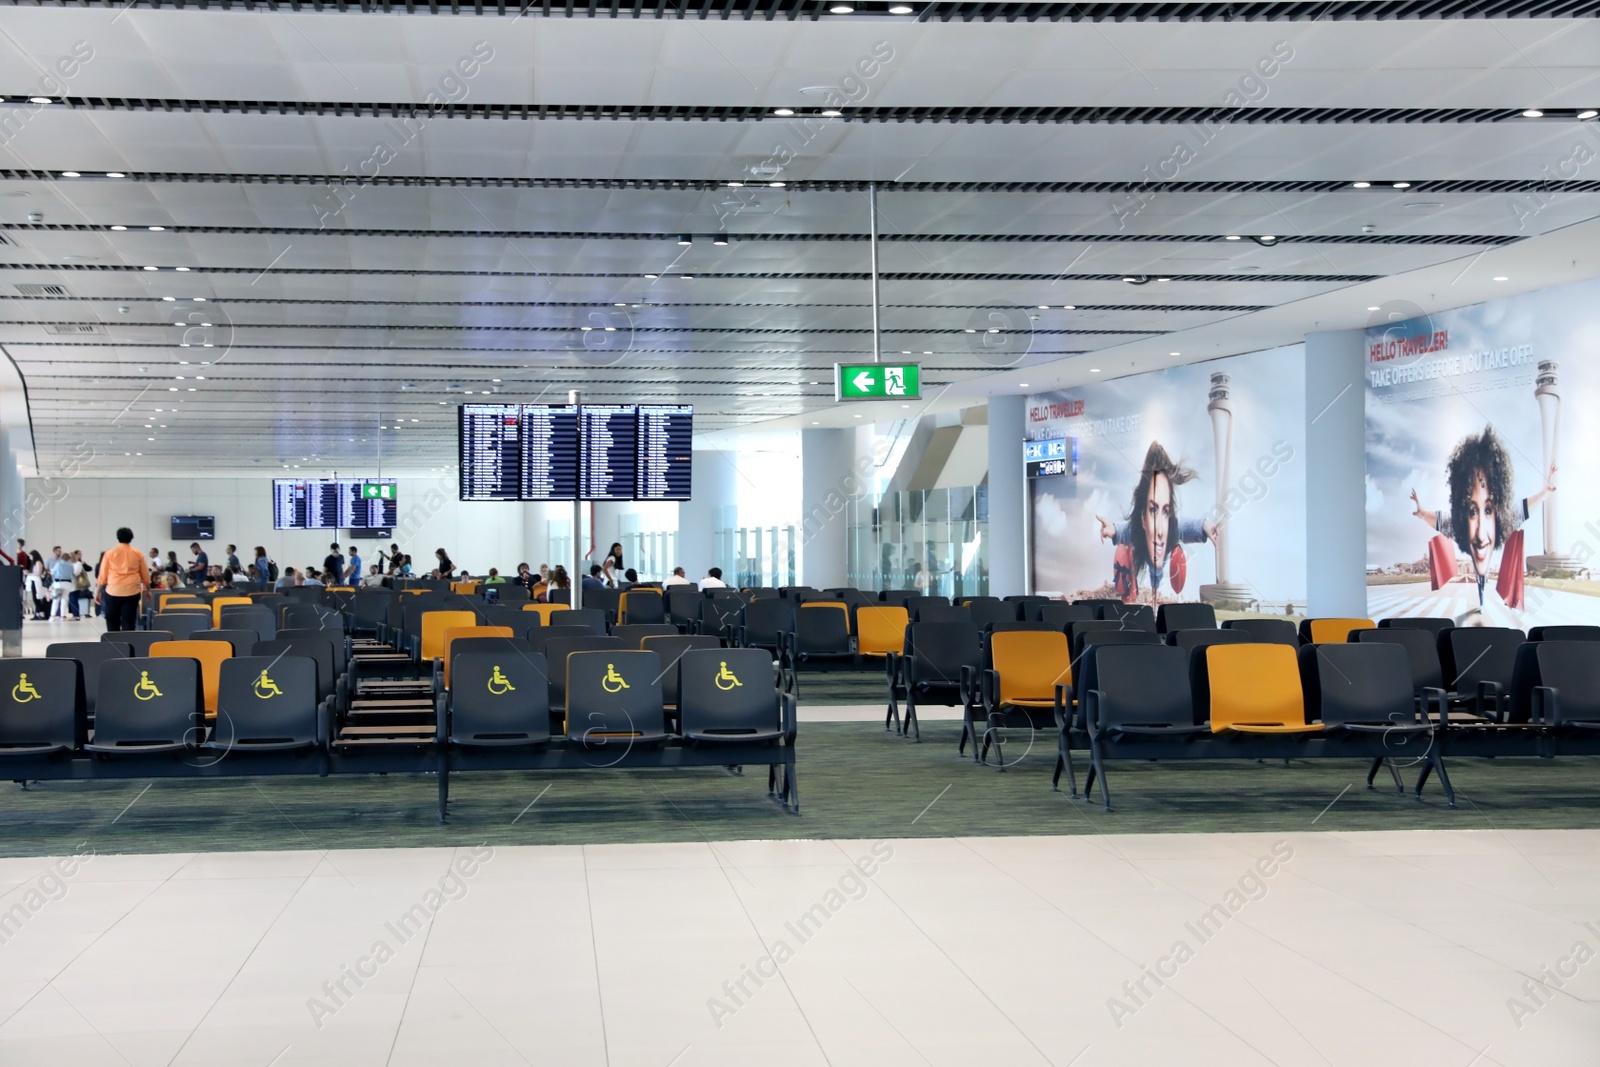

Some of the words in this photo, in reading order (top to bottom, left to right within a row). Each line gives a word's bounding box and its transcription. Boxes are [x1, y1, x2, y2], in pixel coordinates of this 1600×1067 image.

[1370, 338, 1395, 363] HELLO
[1397, 329, 1449, 358] TRAVELLER!
[1370, 367, 1391, 388] TAKE
[1392, 362, 1424, 385] OFFERS
[1425, 356, 1460, 380] BEFORE
[1460, 352, 1482, 374] YOU
[1482, 347, 1508, 371] TAKE
[1509, 343, 1533, 367] OFF!
[1030, 405, 1049, 422] HELLO
[1049, 399, 1084, 420] TRAVELLER!
[1107, 416, 1125, 434] TAKE
